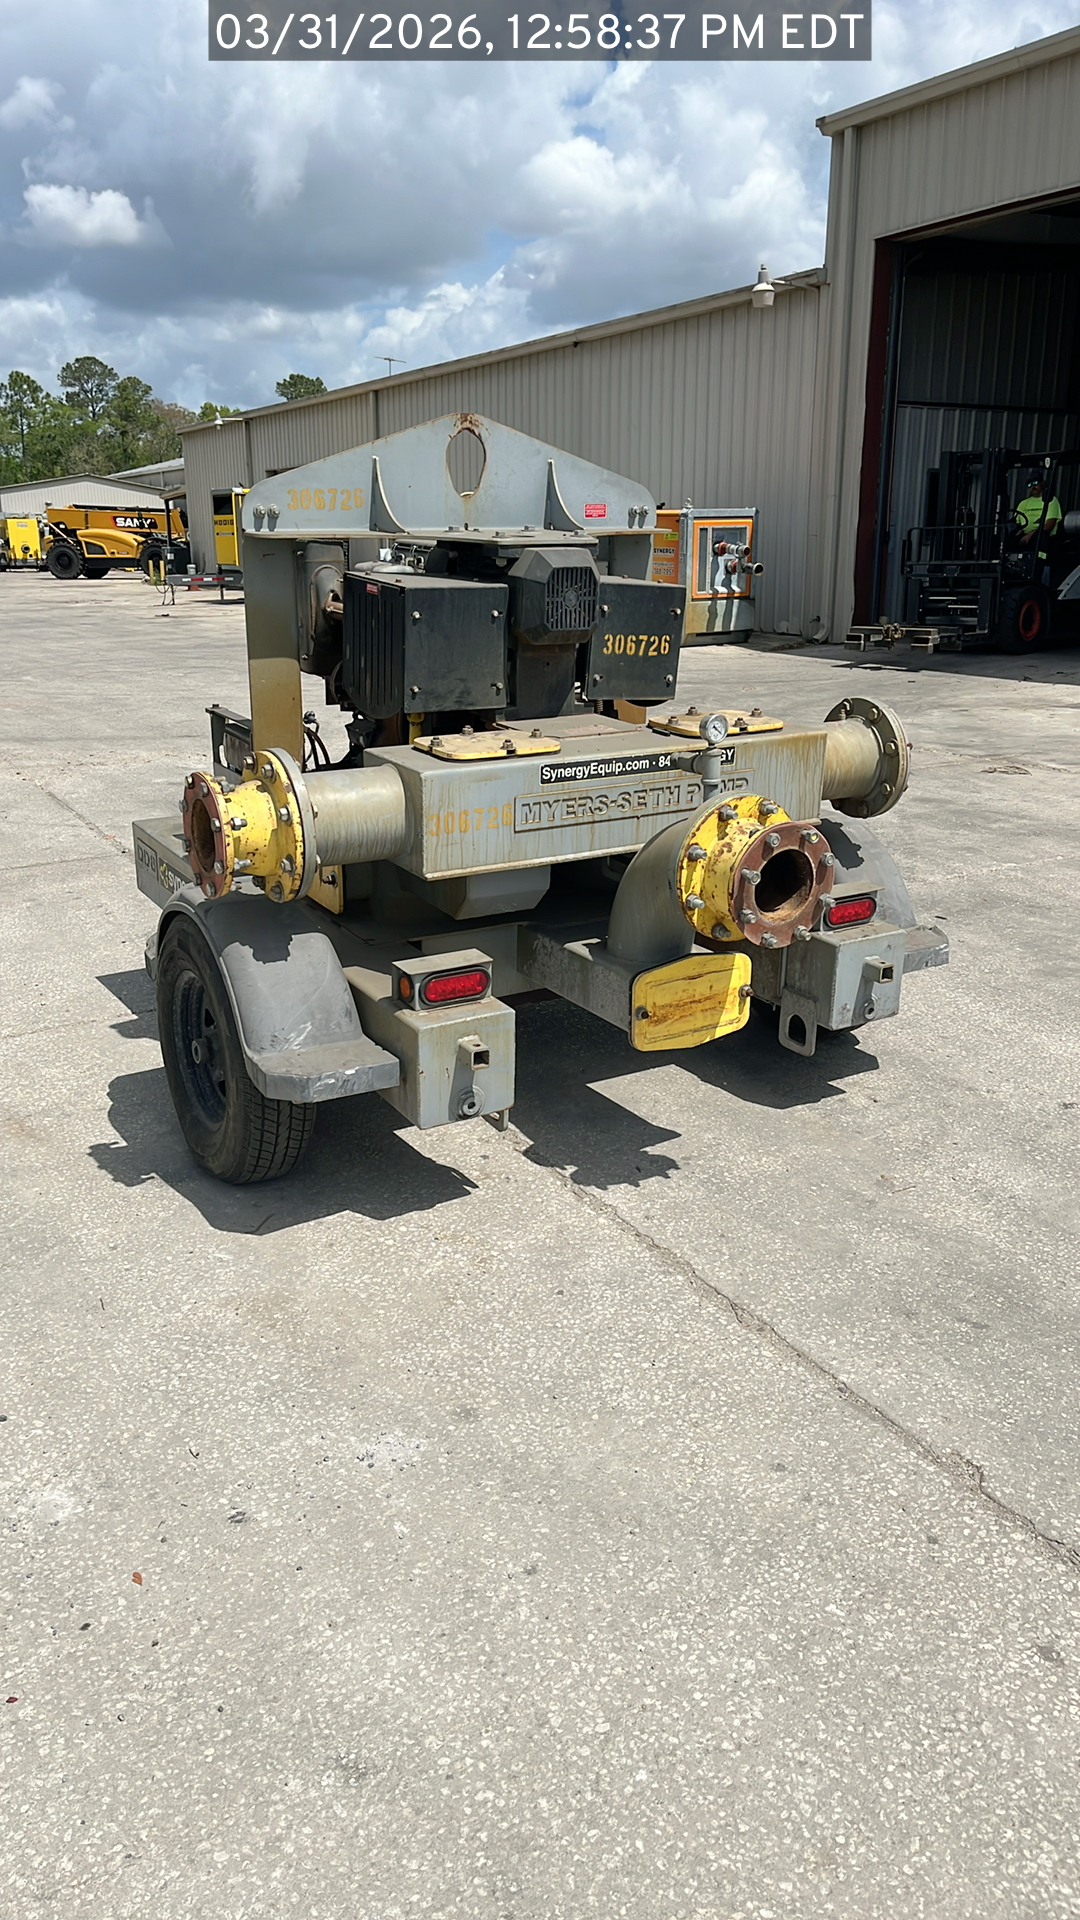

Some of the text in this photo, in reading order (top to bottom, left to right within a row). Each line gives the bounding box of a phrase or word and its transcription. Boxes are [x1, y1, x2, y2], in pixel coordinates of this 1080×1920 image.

[287, 487, 364, 512] 306726
[115, 516, 152, 529] SANY
[602, 633, 671, 656] 306726
[541, 758, 650, 782] SynergyEquip.com
[520, 777, 749, 825] MYERS-SETH PMP
[429, 802, 513, 837] 306726
